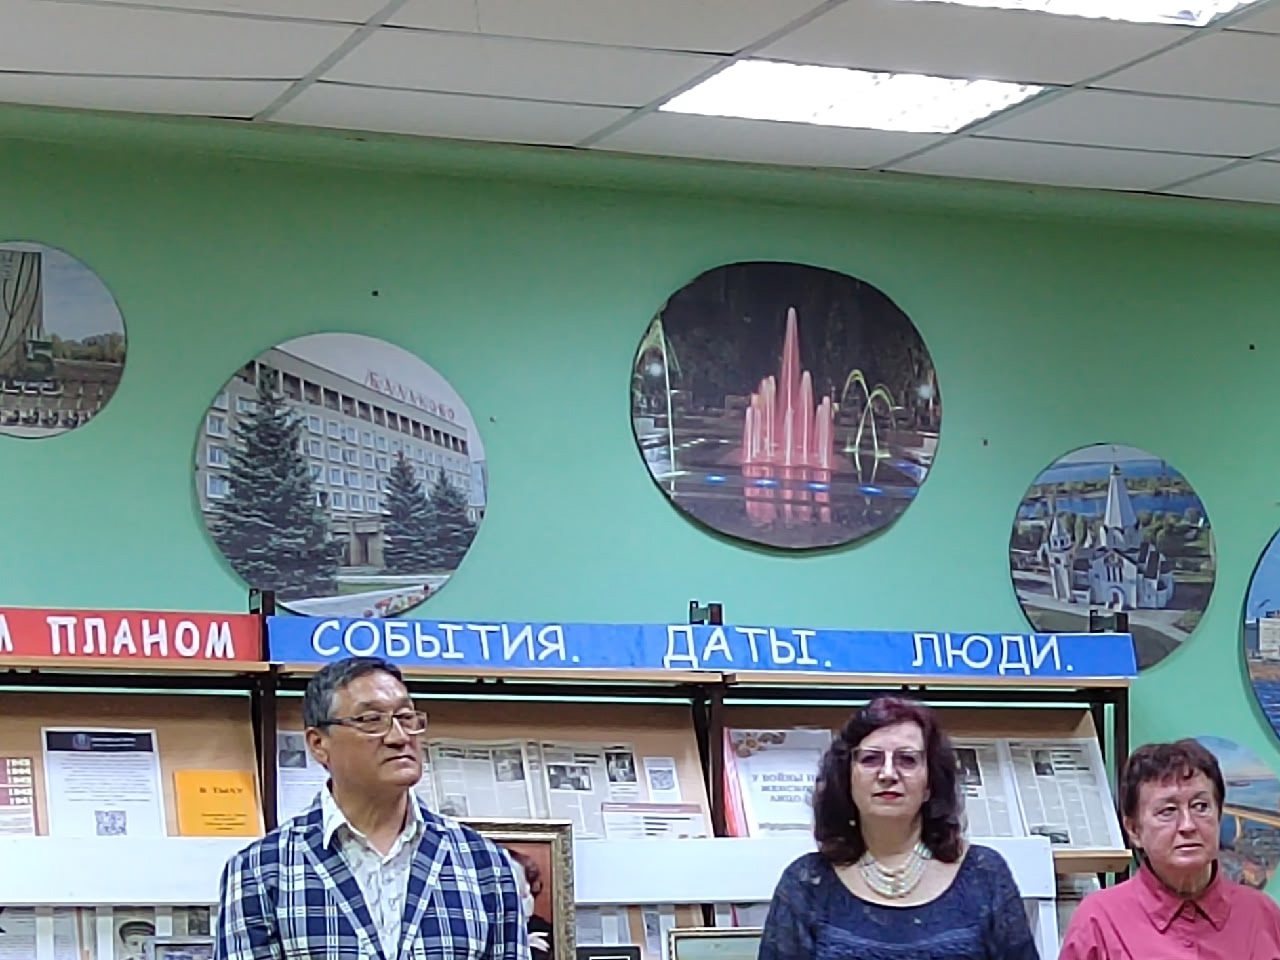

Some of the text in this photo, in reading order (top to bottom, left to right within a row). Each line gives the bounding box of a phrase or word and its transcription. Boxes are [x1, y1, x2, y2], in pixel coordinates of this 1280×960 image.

[47, 616, 235, 659] ПЛАНОМ
[311, 620, 1073, 675] СОБЫТИЯ. ДАТЫ. ЛЮДИ.
